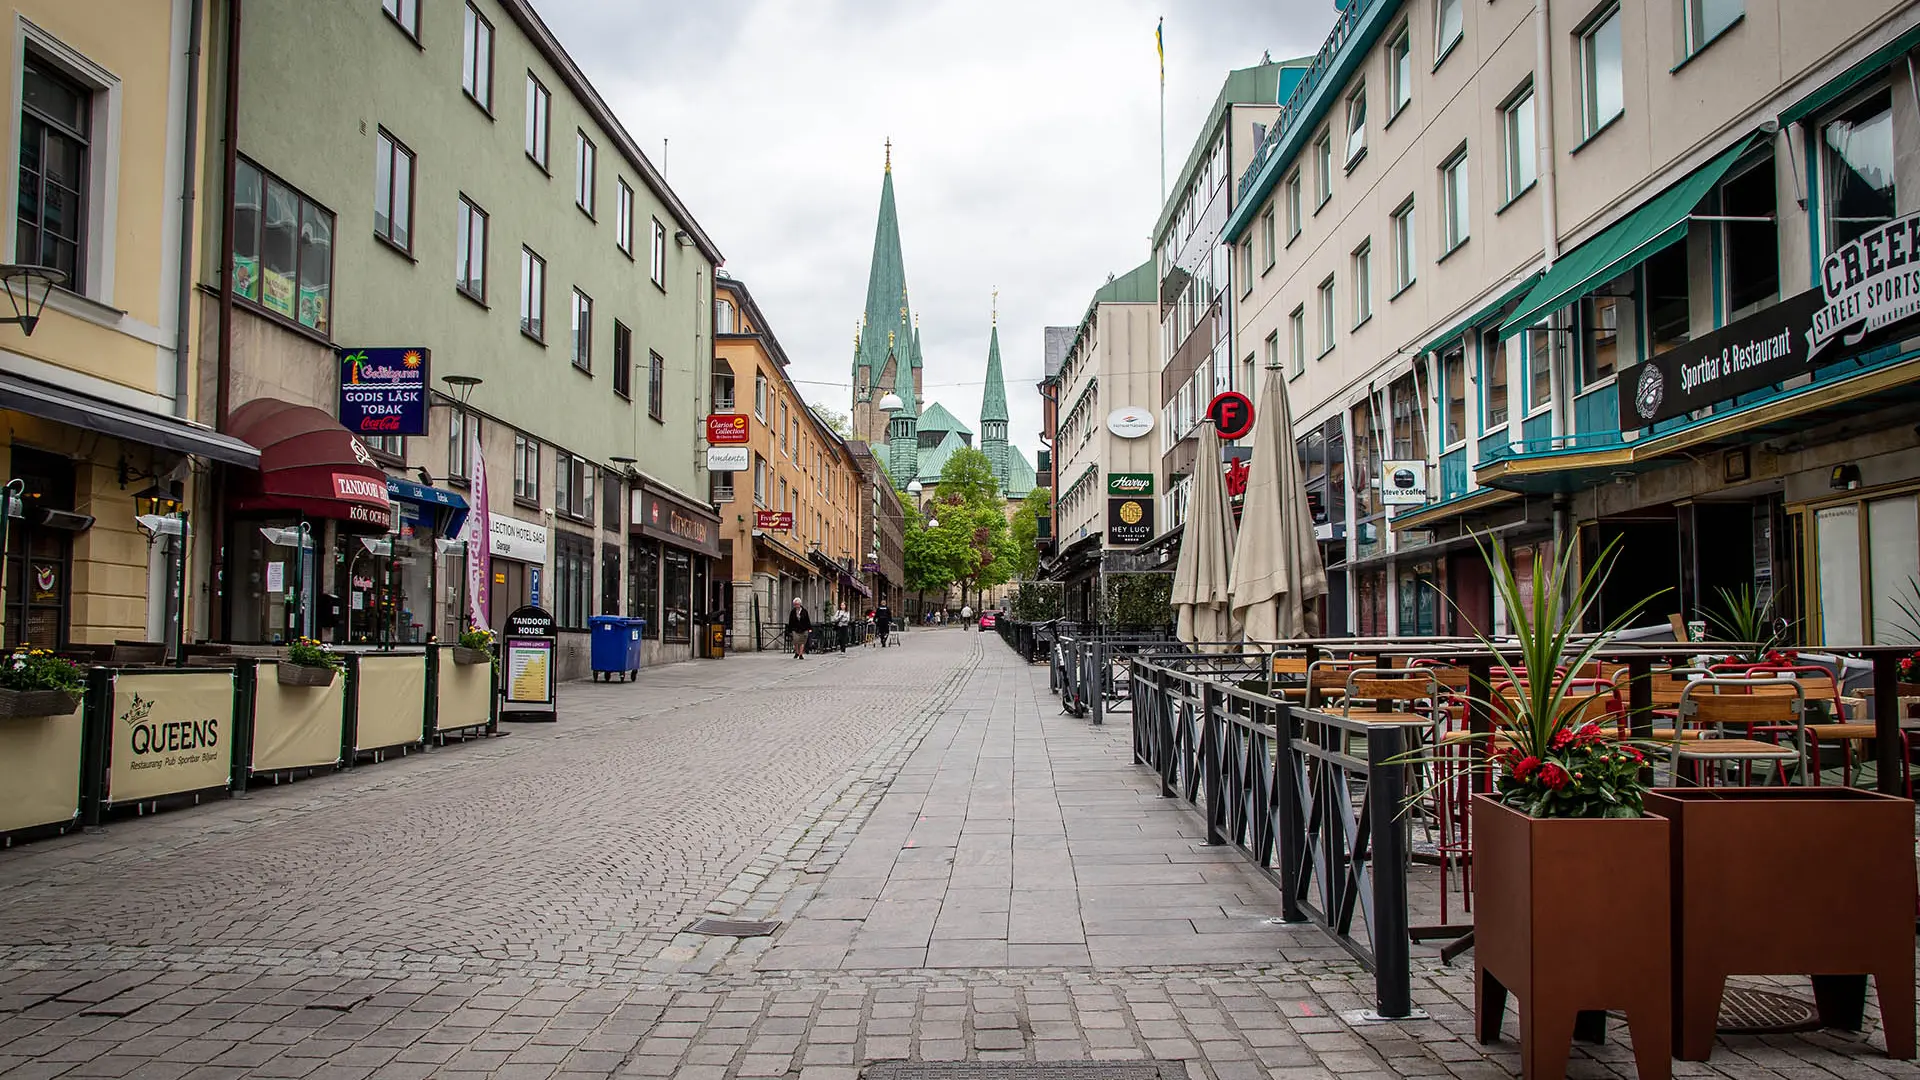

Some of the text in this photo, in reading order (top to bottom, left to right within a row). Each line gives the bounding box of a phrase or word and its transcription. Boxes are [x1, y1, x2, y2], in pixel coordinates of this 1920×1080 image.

[1816, 270, 1920, 335] STREET SPORTS
[1681, 355, 1720, 395] Sportbar
[1722, 347, 1731, 376] &
[1732, 326, 1792, 373] Restaurant
[345, 390, 419, 402] GODIS LÄSK
[361, 404, 403, 414] TOBAK
[1221, 402, 1239, 428] F
[710, 419, 733, 429] Clarion
[338, 478, 379, 498] TANDOORI
[1111, 476, 1150, 491] Harrys
[1383, 488, 1426, 496] steve's coffee
[516, 527, 531, 542] HOTEL
[532, 530, 545, 544] SAGA
[496, 539, 511, 553] Garage
[533, 571, 538, 590] P
[512, 617, 551, 626] TANDOORI
[518, 627, 544, 635] HOUSE
[132, 719, 218, 754] QUEENS
[130, 752, 218, 770] Restaurang Pub Sportbar Biljard
